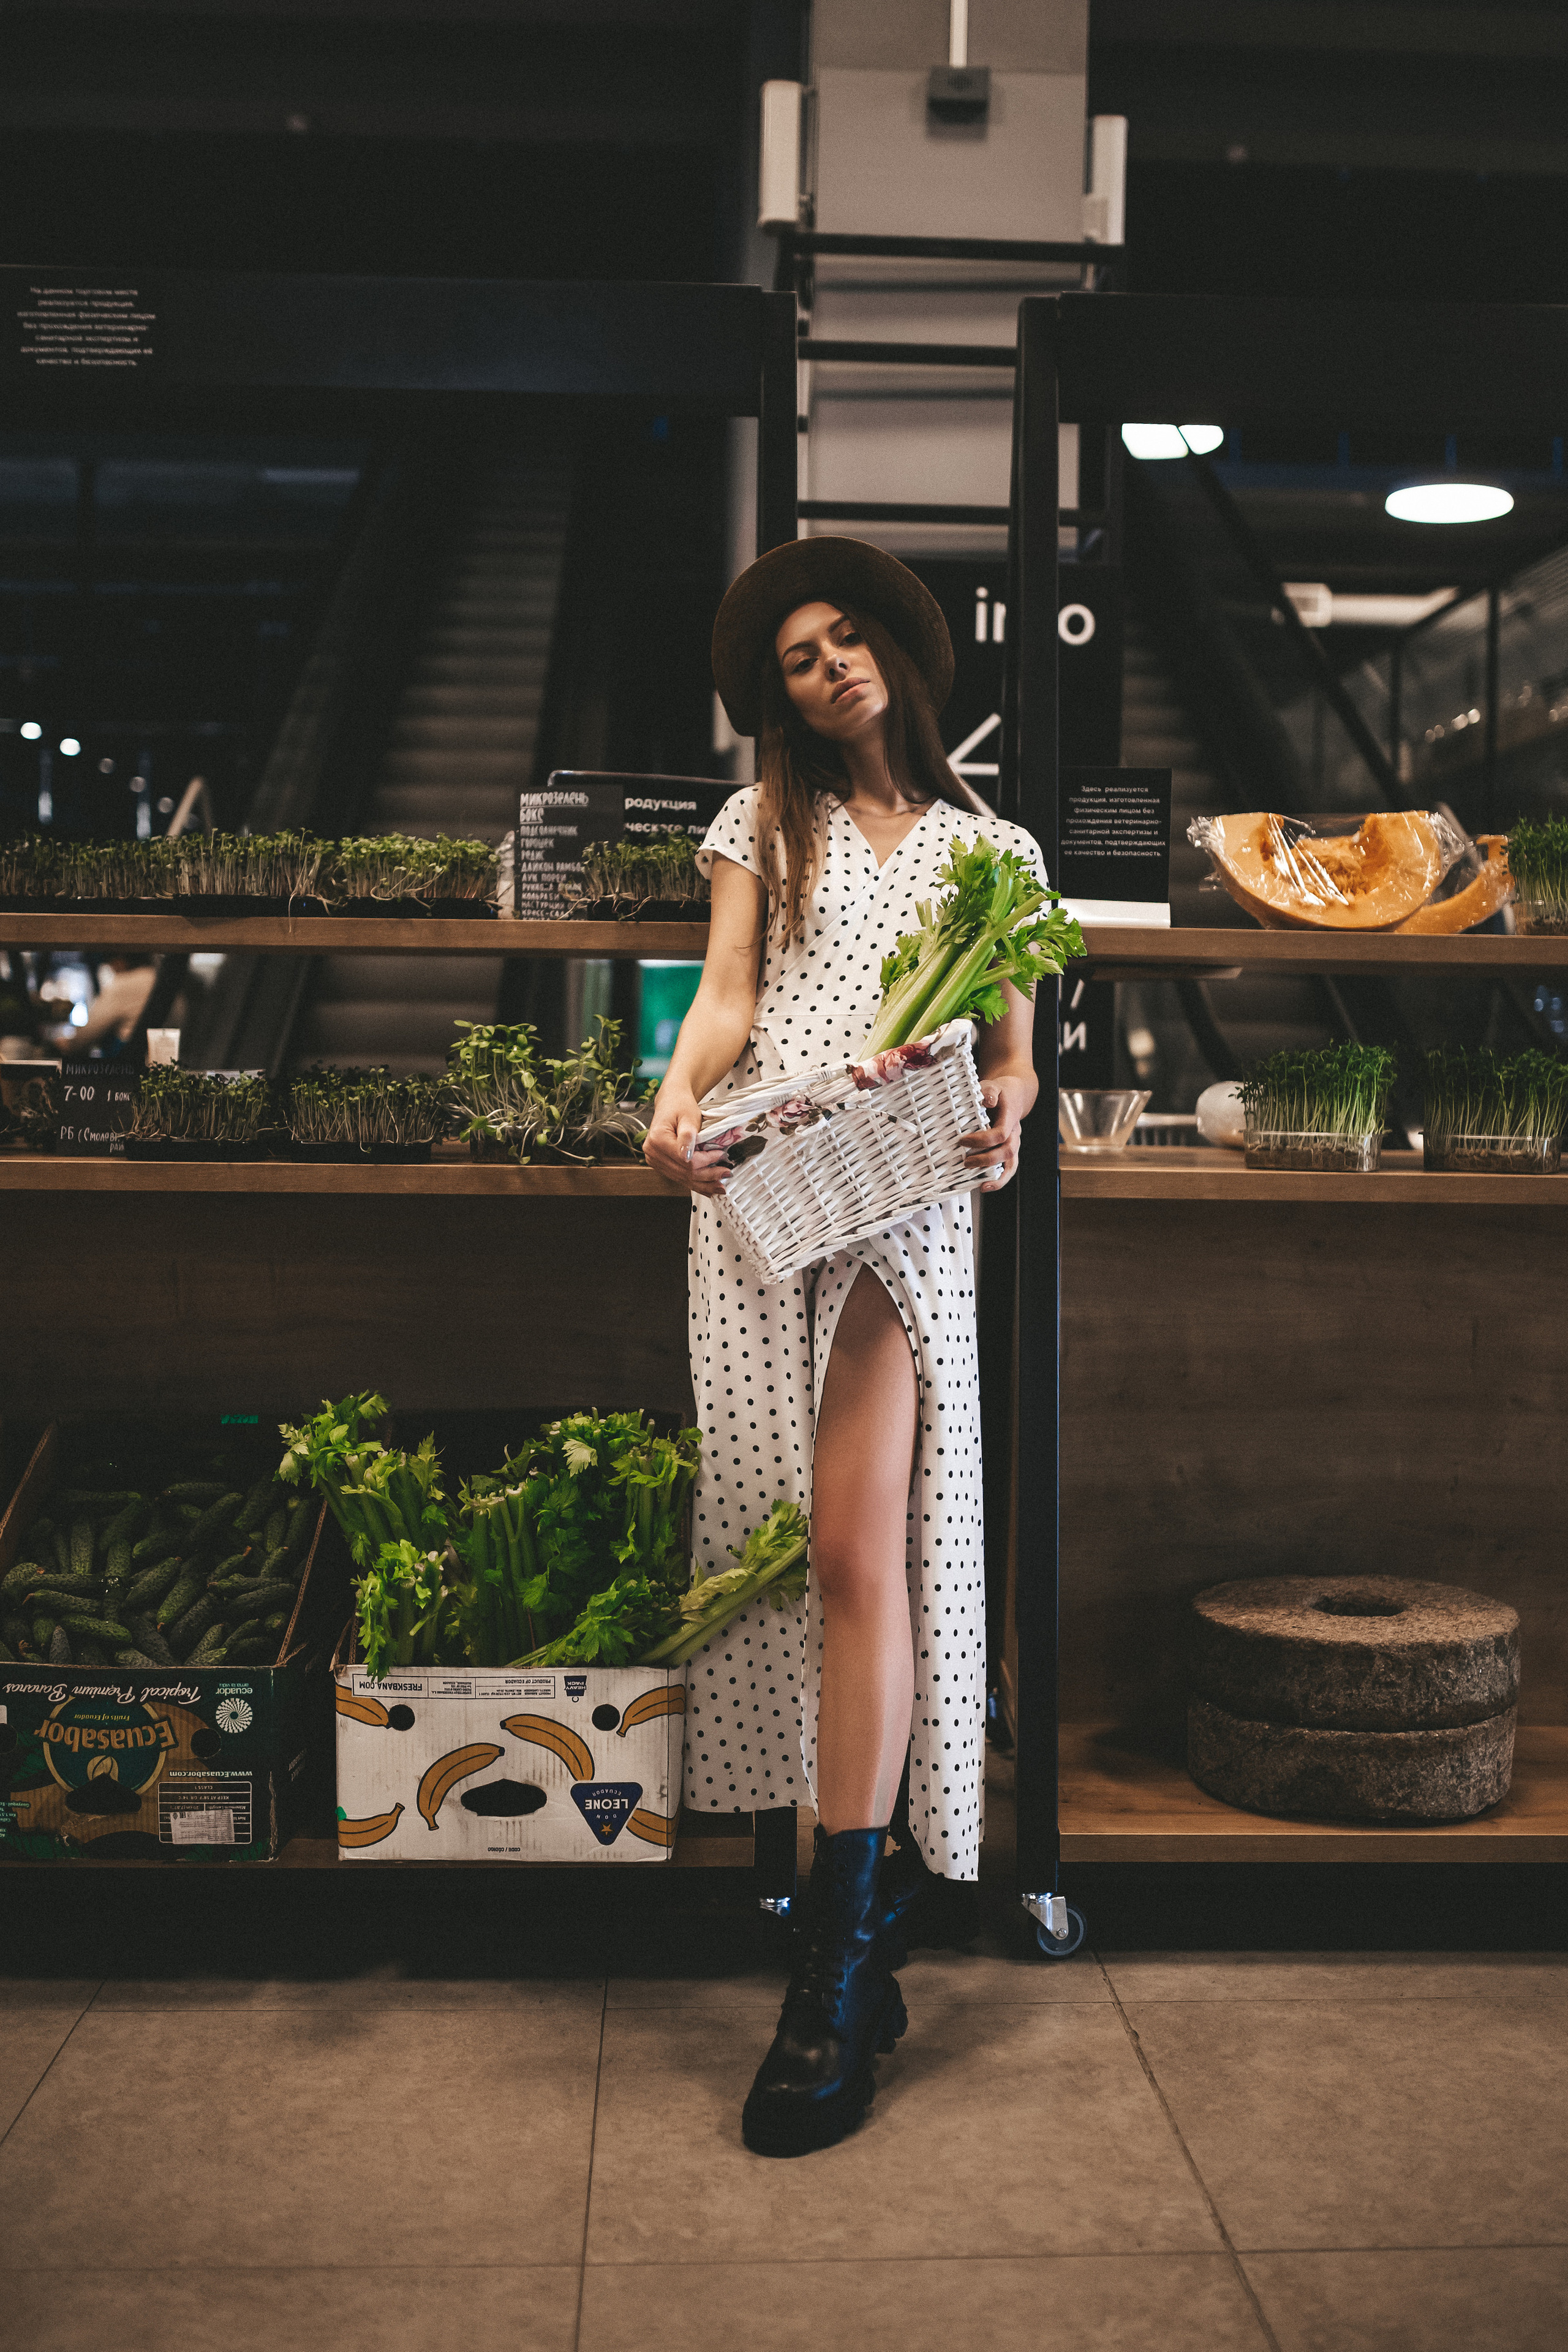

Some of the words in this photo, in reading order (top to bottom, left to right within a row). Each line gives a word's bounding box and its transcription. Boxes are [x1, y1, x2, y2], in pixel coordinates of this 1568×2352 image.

[624, 797, 697, 811] родукция
[520, 807, 545, 822] БОКС
[64, 1085, 96, 1101] 7-00
[60, 1126, 74, 1140] РБ
[2, 1683, 67, 1702] Bananas
[359, 1681, 423, 1691] FRESKBANA.COM
[72, 1686, 136, 1704] Premium
[140, 1686, 201, 1704] Tropical
[34, 1719, 176, 1753] Ecuasabor
[584, 1799, 629, 1810] LEONE
